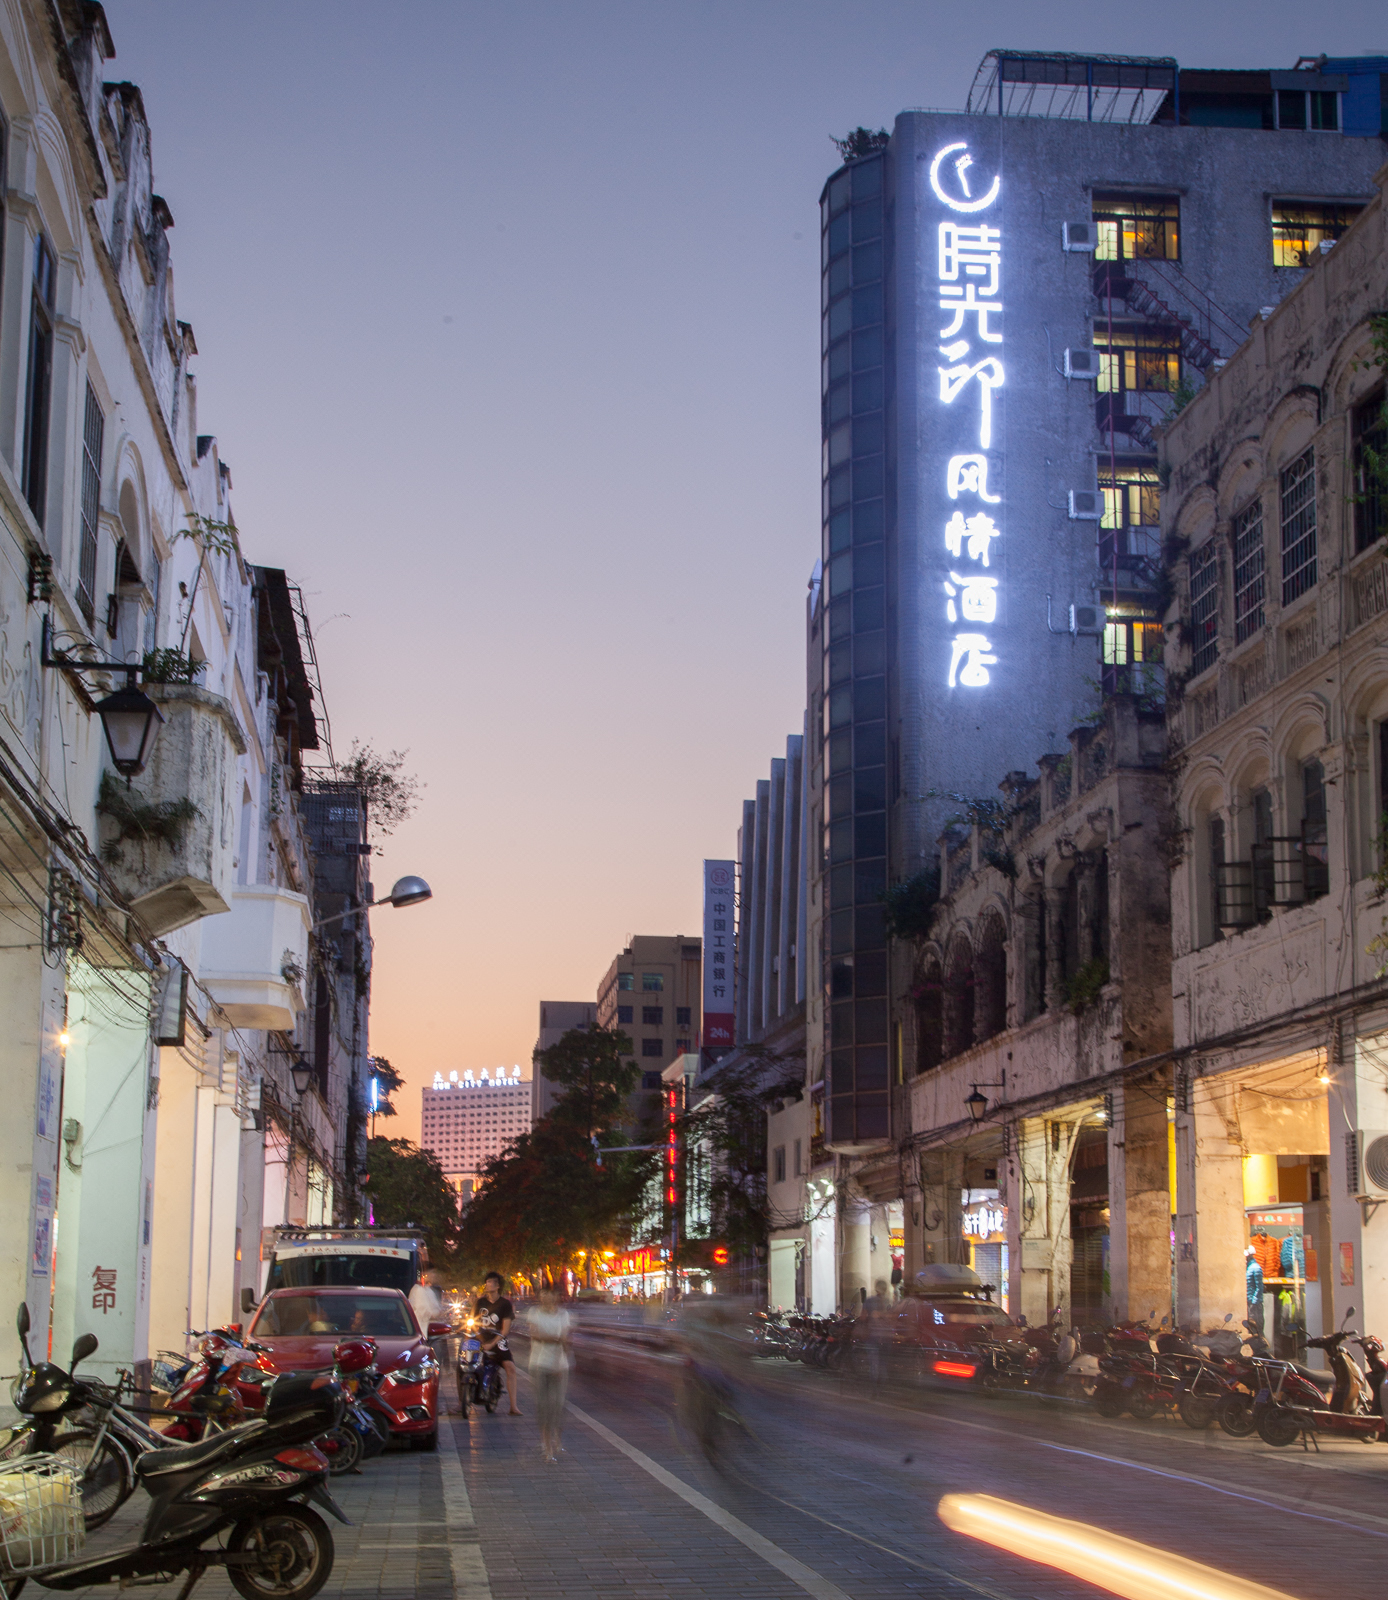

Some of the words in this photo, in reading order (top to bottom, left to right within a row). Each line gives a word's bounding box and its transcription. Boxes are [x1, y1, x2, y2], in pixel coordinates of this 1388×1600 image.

[713, 902, 726, 998] 中国工商银行
[709, 1026, 730, 1039] 24h
[457, 1078, 483, 1089] CITY
[488, 1077, 520, 1088] HOTEL
[91, 1264, 118, 1315] 复印
